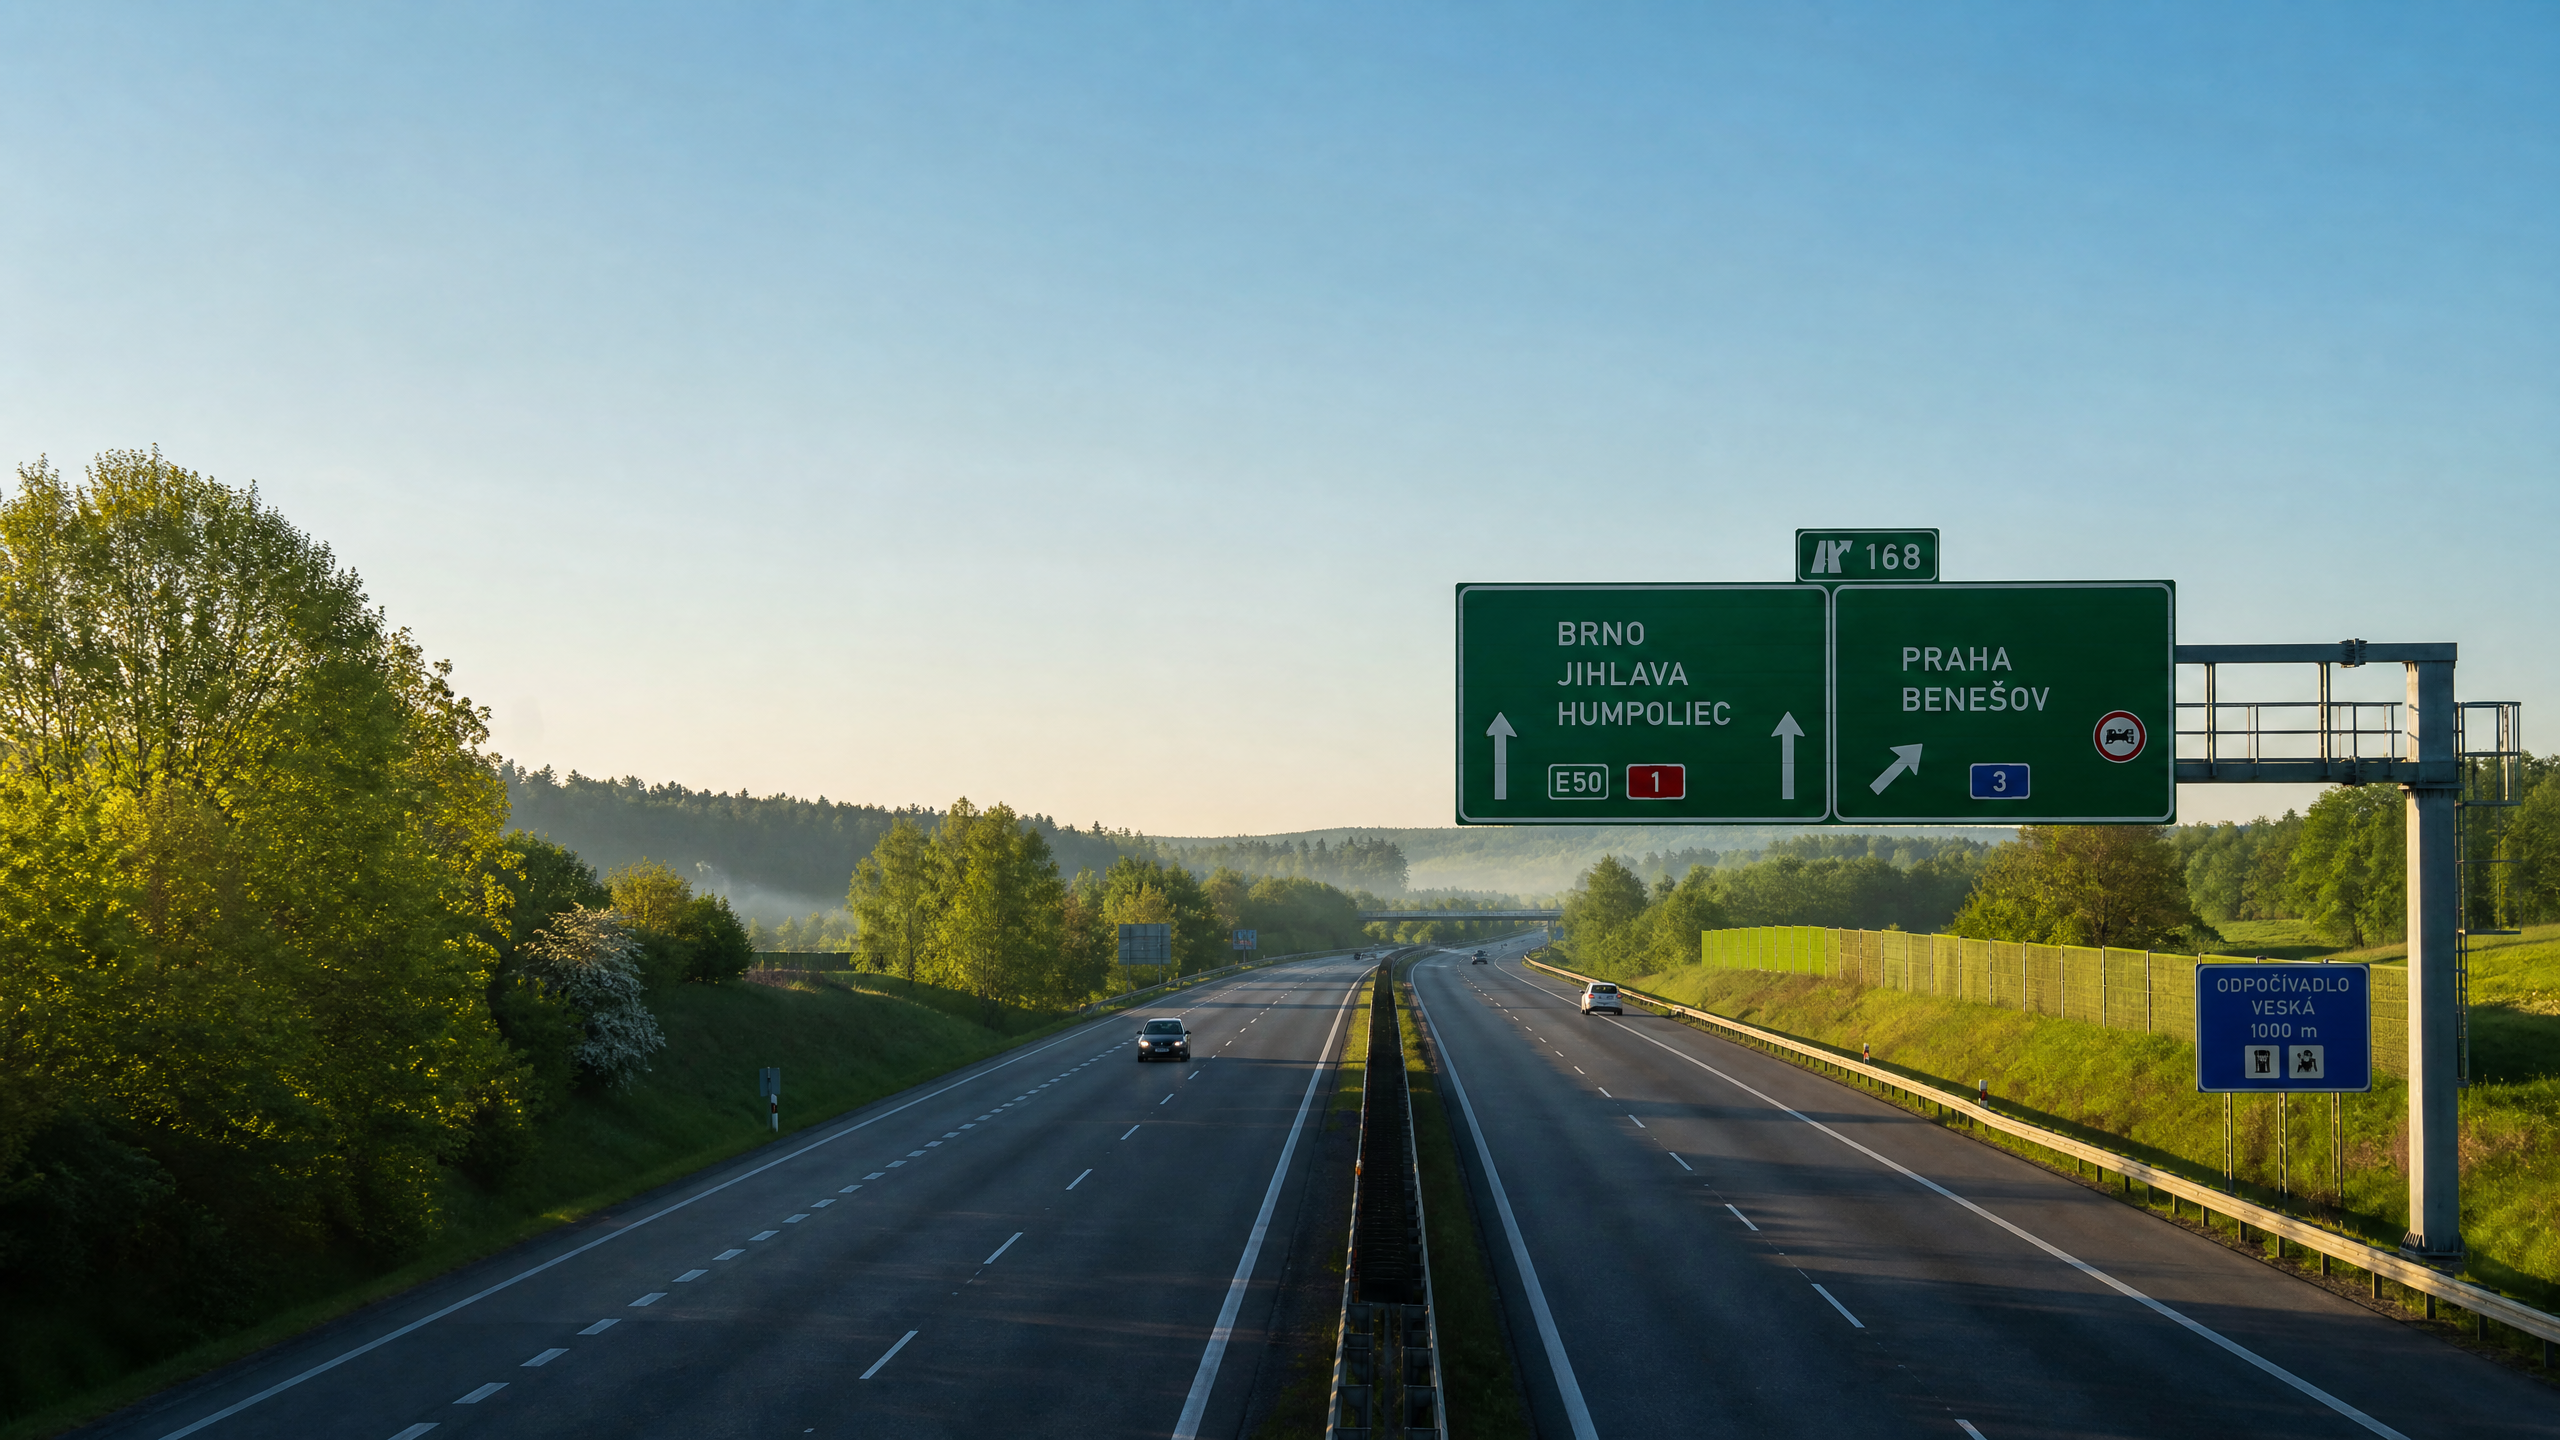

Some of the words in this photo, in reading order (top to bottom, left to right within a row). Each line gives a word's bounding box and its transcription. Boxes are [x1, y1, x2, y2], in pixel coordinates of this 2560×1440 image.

[1866, 544, 1920, 569] 168
[1559, 622, 1644, 645] BRNO
[1903, 647, 2012, 671] PRAHA
[1558, 662, 1688, 685] JIHLAVA
[1903, 681, 2049, 711] BENEŠOV
[1559, 702, 1730, 725] HUMPOLIEC
[1557, 772, 1601, 792] E50
[1651, 771, 1659, 792] 1
[1994, 771, 2006, 791] 3
[2218, 974, 2349, 992] ODPOČÍVADLO
[2252, 996, 2315, 1015] VESKÁ
[2251, 1023, 2291, 1037] 1000
[2302, 1027, 2317, 1037] m
